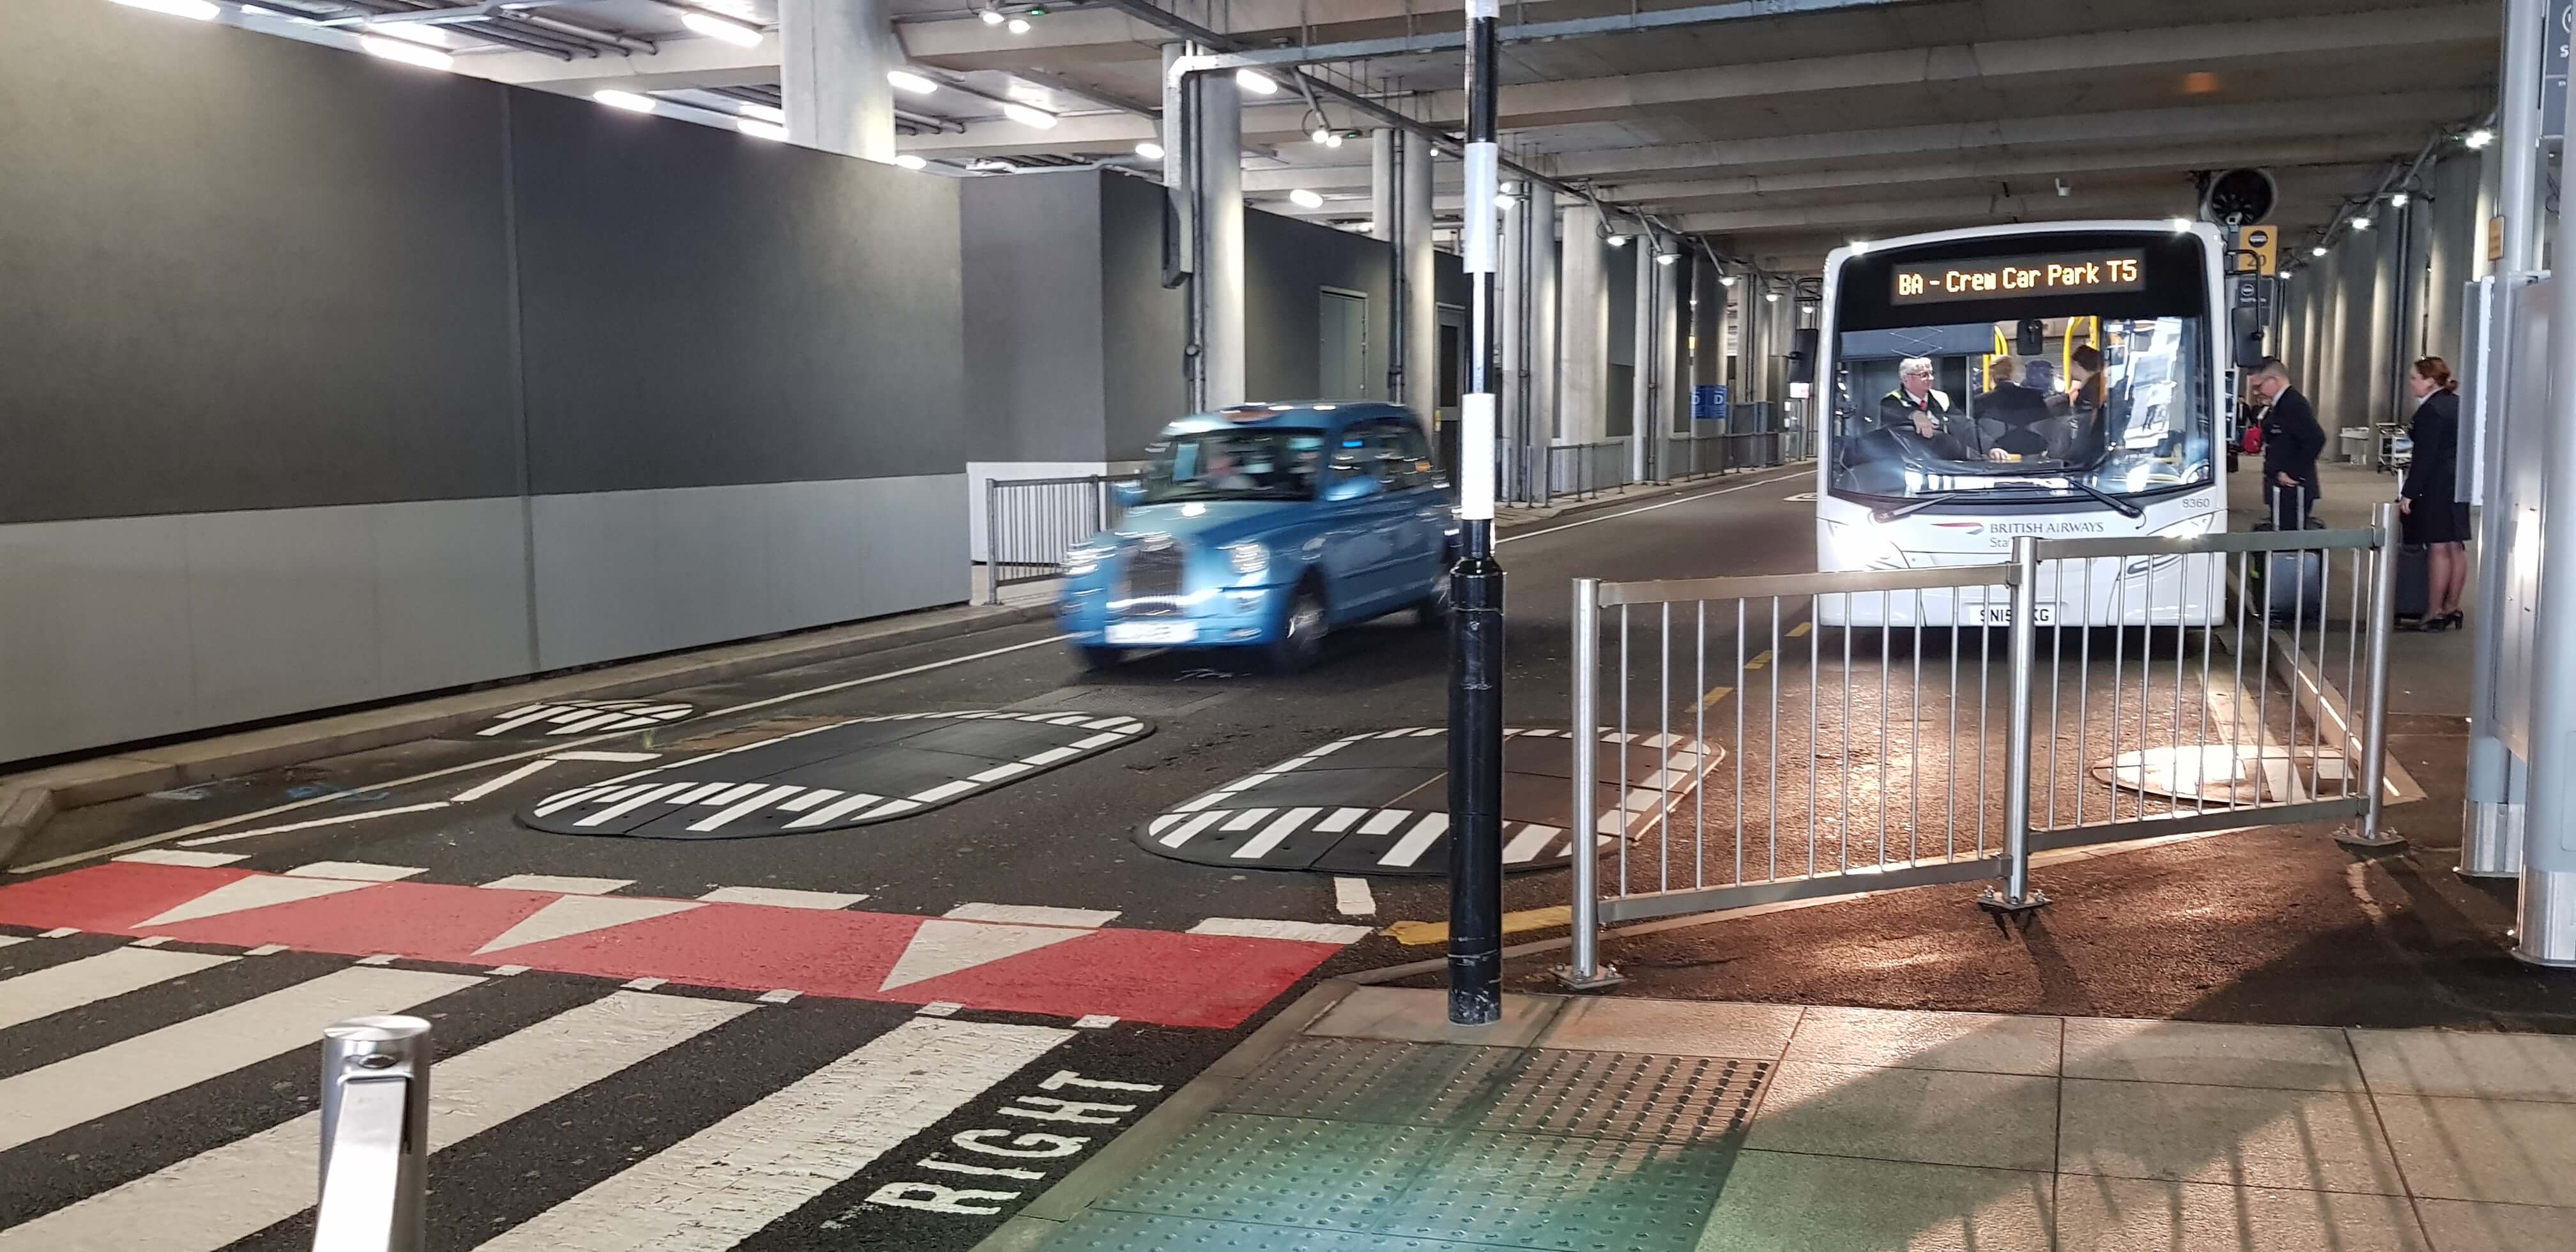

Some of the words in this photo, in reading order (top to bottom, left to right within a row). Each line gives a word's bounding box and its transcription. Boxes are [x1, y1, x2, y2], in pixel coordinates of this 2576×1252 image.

[1897, 273, 1924, 296] BA
[1945, 270, 1997, 293] Crew
[2002, 267, 2041, 289] Car
[2047, 262, 2100, 287] Park
[2106, 259, 2138, 282] T5
[1714, 394, 1724, 404] D
[2182, 498, 2211, 508] 8360
[1989, 523, 2043, 534] BRITISH
[2045, 521, 2104, 533] AIRWAYS
[1989, 537, 2010, 547] Sta
[864, 1069, 1165, 1216] RIGHT
